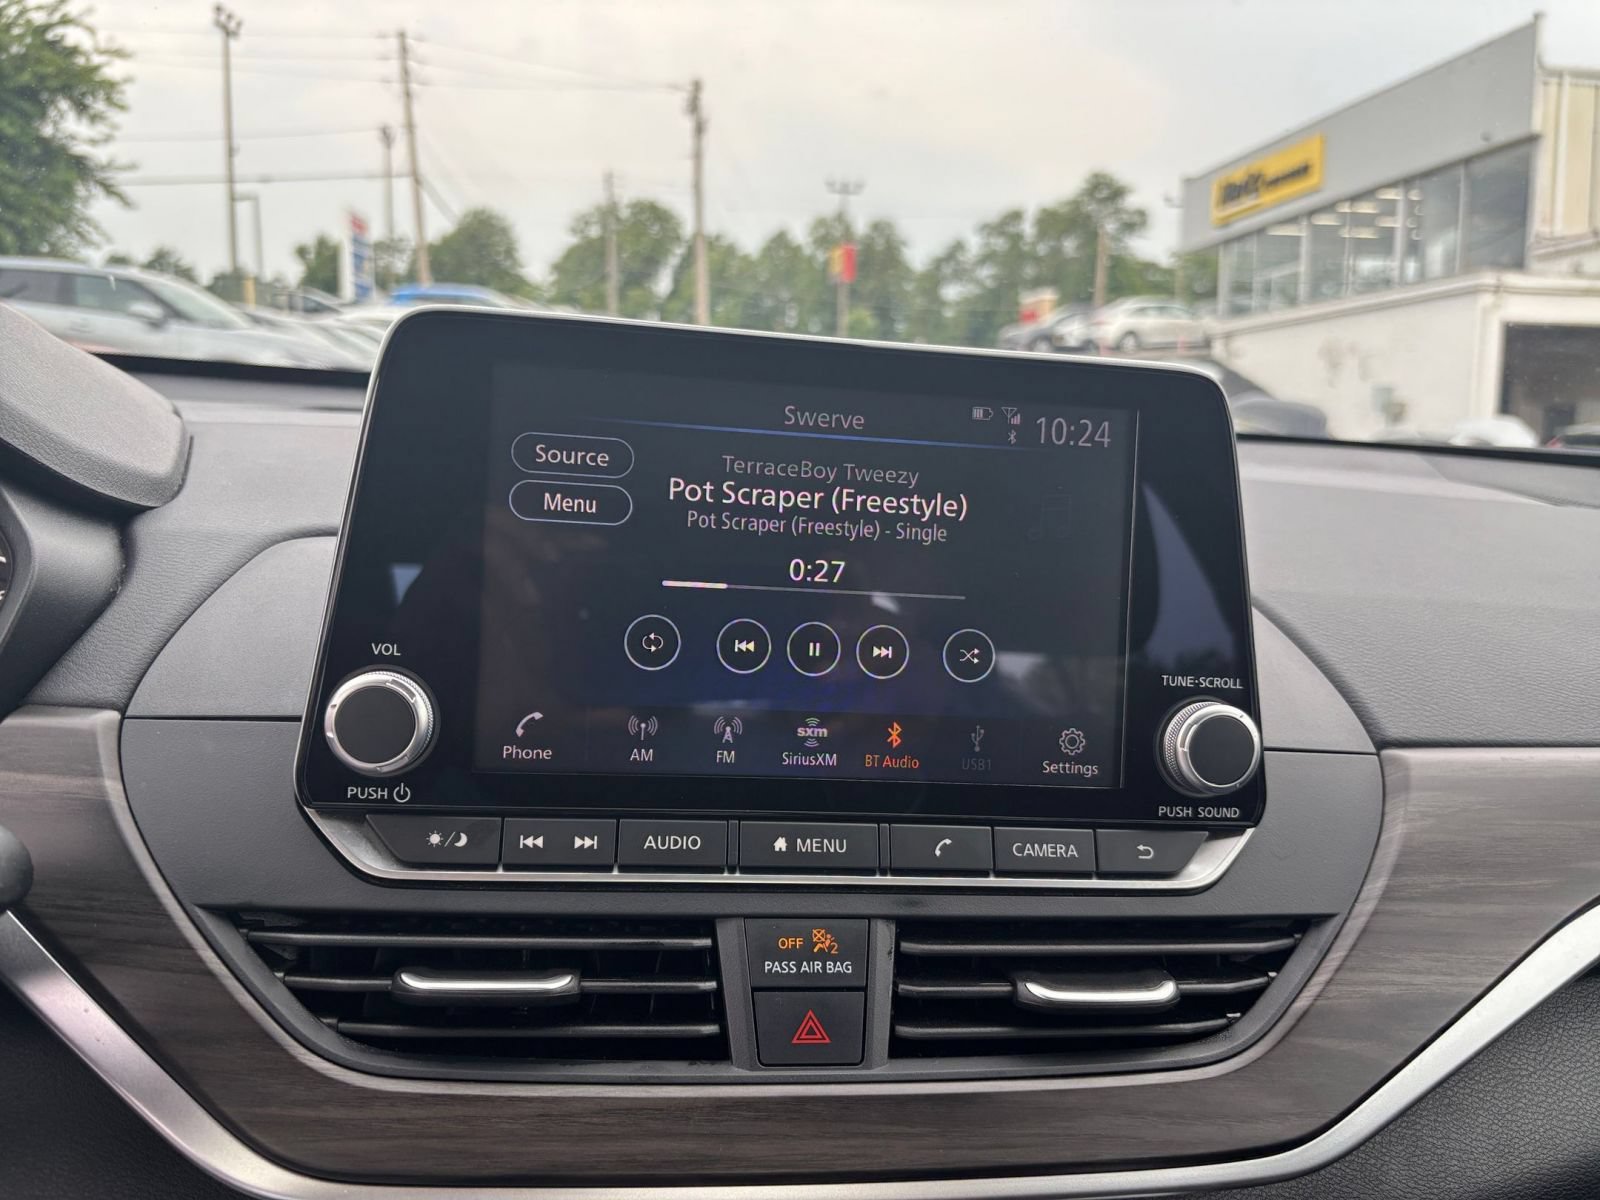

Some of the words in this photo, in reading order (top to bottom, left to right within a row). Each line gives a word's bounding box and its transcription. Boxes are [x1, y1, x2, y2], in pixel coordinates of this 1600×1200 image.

[784, 406, 865, 430] Swerve
[1036, 416, 1111, 449] 10:24
[535, 445, 609, 469] Source
[722, 456, 837, 484] TerraceBoy
[843, 464, 920, 488] Tweezy
[543, 493, 597, 514] Menu
[669, 477, 714, 503] Pot
[722, 481, 825, 514] Scraper
[832, 486, 967, 520] (Freestyle)
[687, 511, 716, 531] Pot
[720, 513, 787, 537] Scraper
[791, 516, 880, 540] (Freestyle)
[895, 522, 947, 545] Single
[789, 559, 846, 584] 0:27
[371, 643, 401, 656] VOL
[797, 727, 828, 737] sxm
[502, 745, 553, 761] Phone
[630, 748, 654, 762] AM
[716, 750, 735, 764] FM
[782, 751, 837, 767] SiriusXM
[865, 754, 880, 768] BT
[883, 755, 919, 769] Audio
[962, 758, 992, 771] USB1
[1043, 760, 1099, 777] Settings
[347, 786, 388, 799] PUSH
[1158, 806, 1192, 818] PUSH
[1197, 806, 1240, 818] SOUND
[643, 835, 701, 851] AUDIO
[796, 838, 847, 853] MENU
[1012, 842, 1078, 858] CAMERA
[778, 937, 804, 949] OFF
[764, 961, 797, 973] PASS
[800, 961, 823, 973] AIR
[826, 961, 852, 973] BAG
